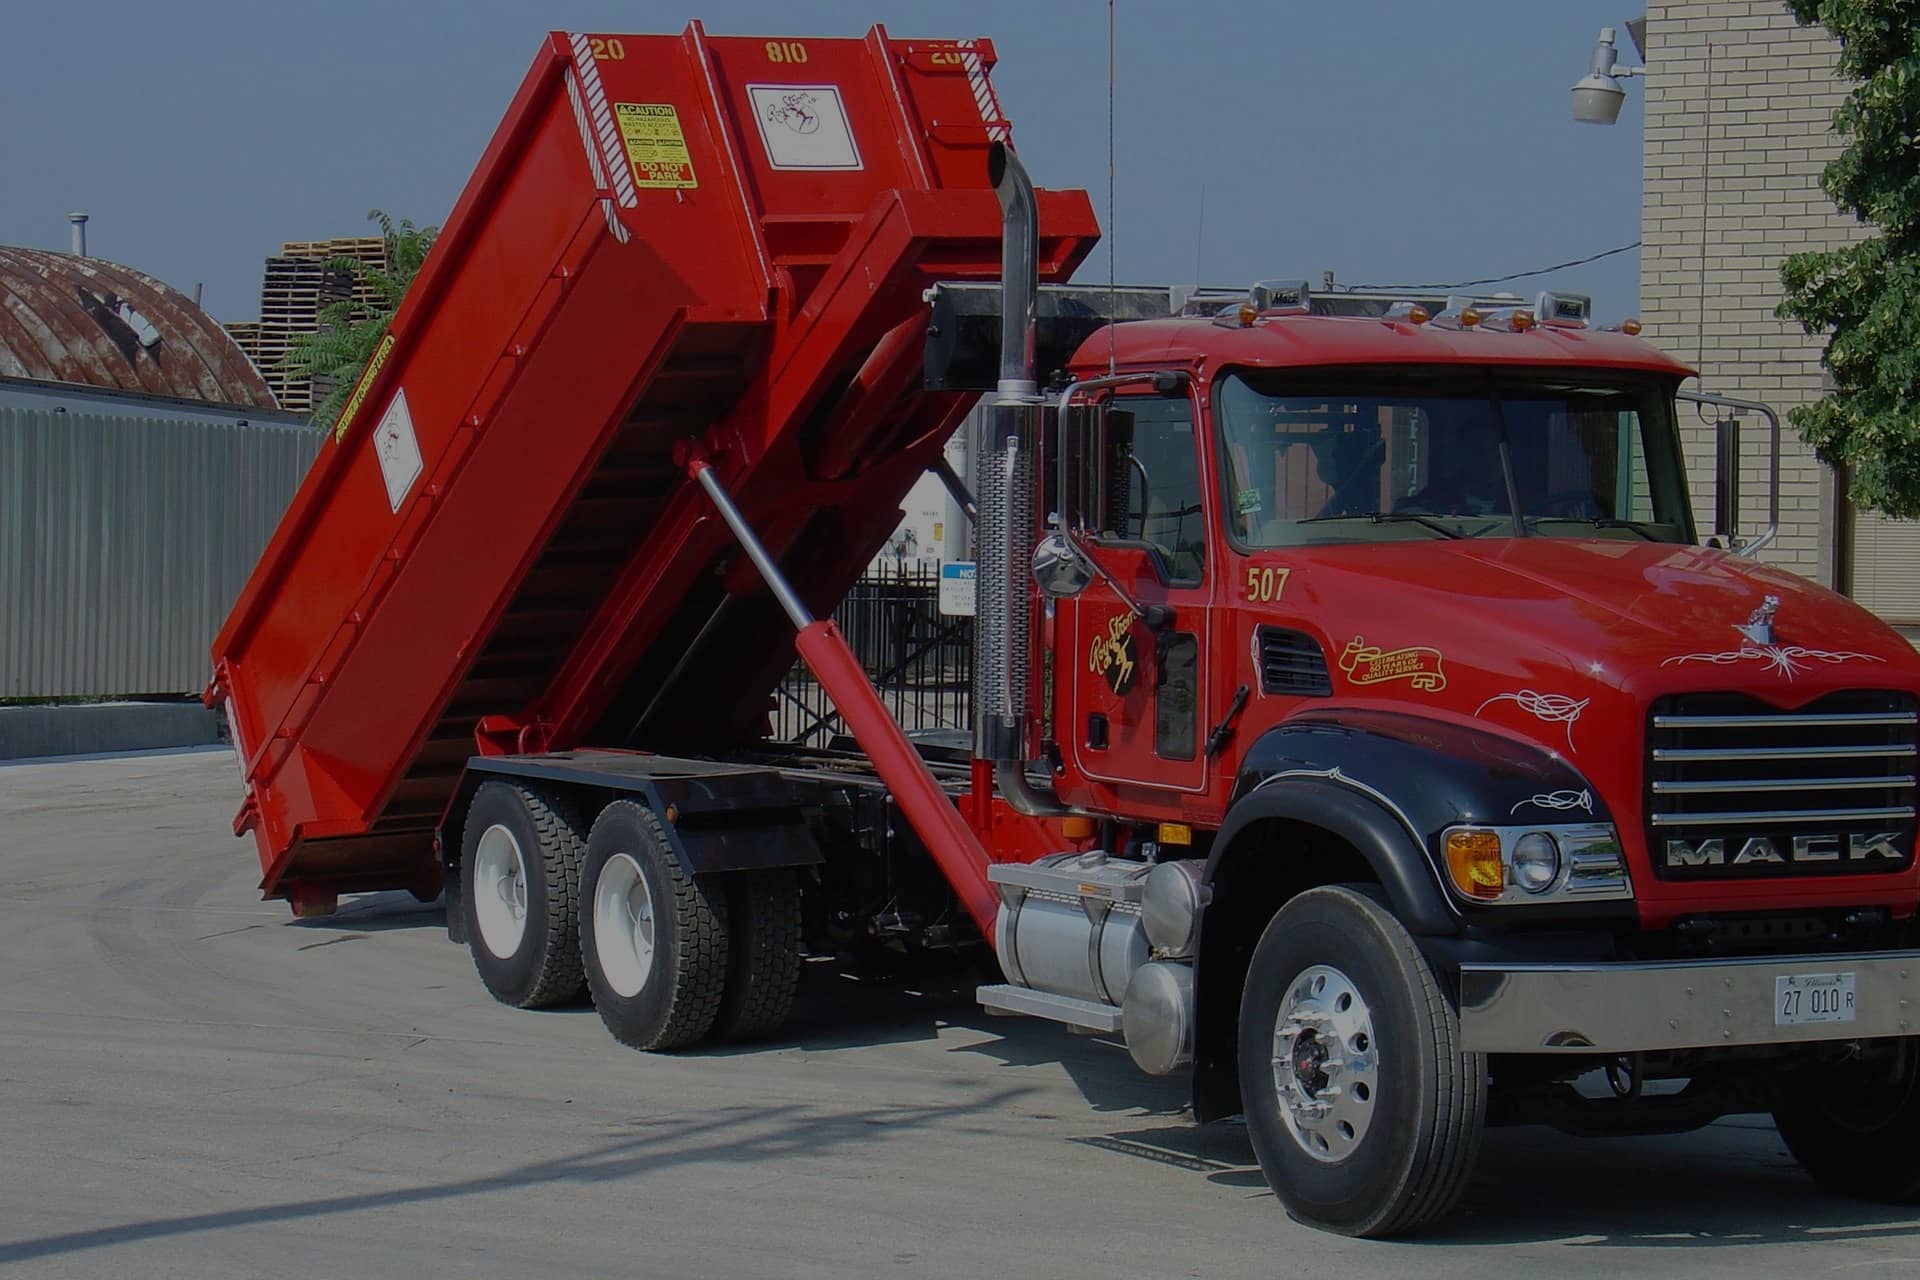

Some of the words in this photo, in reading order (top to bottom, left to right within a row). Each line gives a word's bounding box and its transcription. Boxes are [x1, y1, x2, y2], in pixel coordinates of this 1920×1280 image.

[590, 38, 625, 60] 20
[765, 41, 808, 64] 810
[928, 44, 960, 65] 20
[627, 105, 674, 116] CAUTION
[640, 162, 658, 172] DO
[660, 162, 684, 173] NOT
[648, 171, 682, 181] PARK
[1247, 567, 1290, 602] 507
[1361, 669, 1394, 681] QUALITY
[1395, 662, 1425, 674] SERVICE
[1666, 831, 1904, 867] MACK
[1783, 990, 1801, 1016] 27
[1811, 988, 1840, 1014] 010
[1846, 991, 1854, 1009] R
